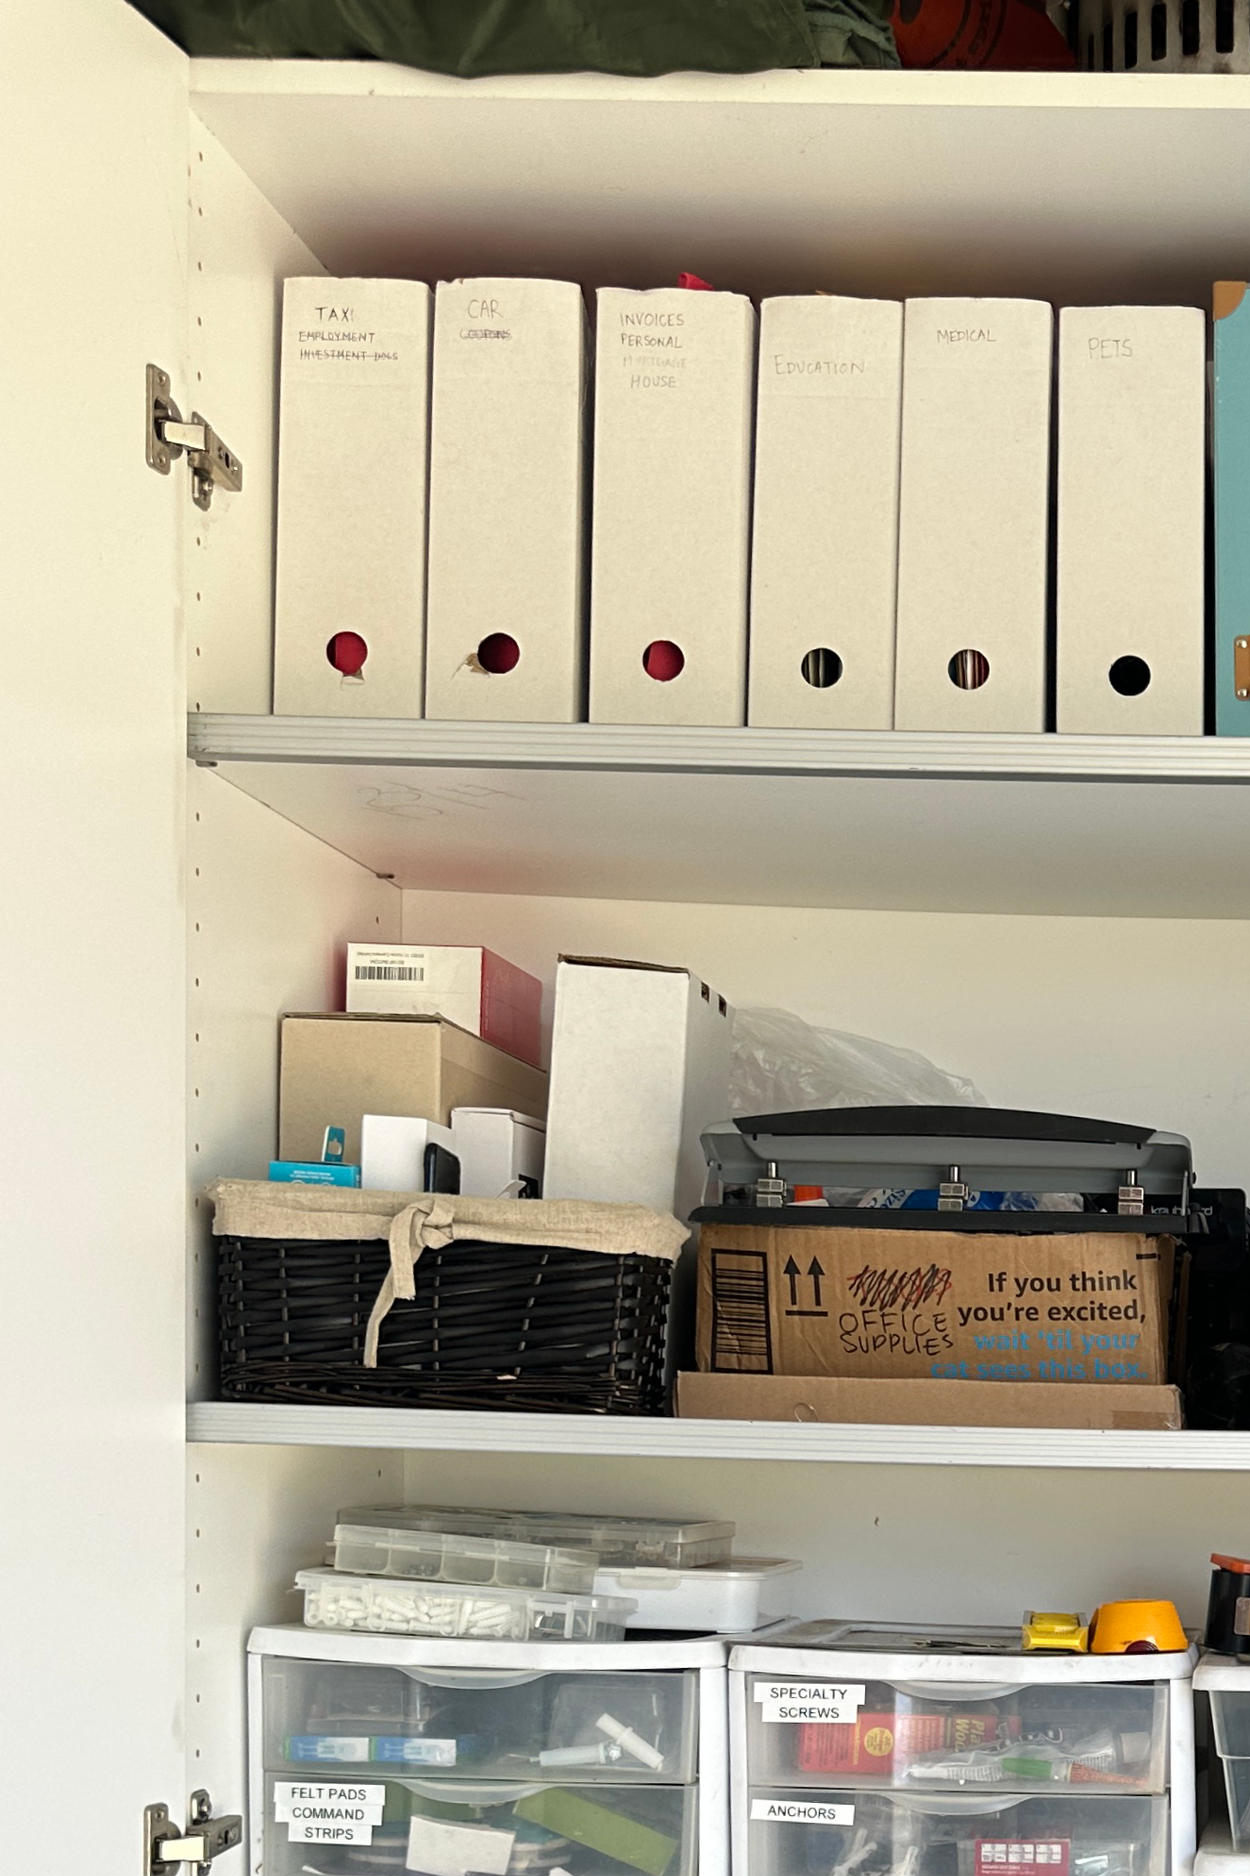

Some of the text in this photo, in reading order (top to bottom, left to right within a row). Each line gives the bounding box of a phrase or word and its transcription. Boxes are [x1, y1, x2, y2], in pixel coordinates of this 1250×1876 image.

[315, 307, 351, 322] TAX
[467, 299, 504, 319] CAR
[620, 312, 685, 327] INVOICES
[620, 333, 683, 348] PERSONAL
[936, 328, 997, 343] MEDICAL
[1087, 337, 1134, 359] PETS
[774, 354, 866, 375] EDUCATION
[630, 374, 678, 389] HOUSE
[988, 1270, 1138, 1298] If you think
[958, 1299, 1147, 1326] you're excited,
[839, 1309, 948, 1336] OFFICE
[839, 1331, 954, 1356] SUPPLIES
[973, 1329, 1141, 1355] wait 'til your
[930, 1358, 1148, 1380] cat sees this box.
[769, 1686, 848, 1701] SPECIALTY
[778, 1706, 840, 1720] SCREWS
[290, 1787, 367, 1801] FELT PADS
[292, 1806, 365, 1821] COMMAND
[766, 1804, 837, 1820] ANCHORS
[304, 1827, 354, 1841] STRIPS
